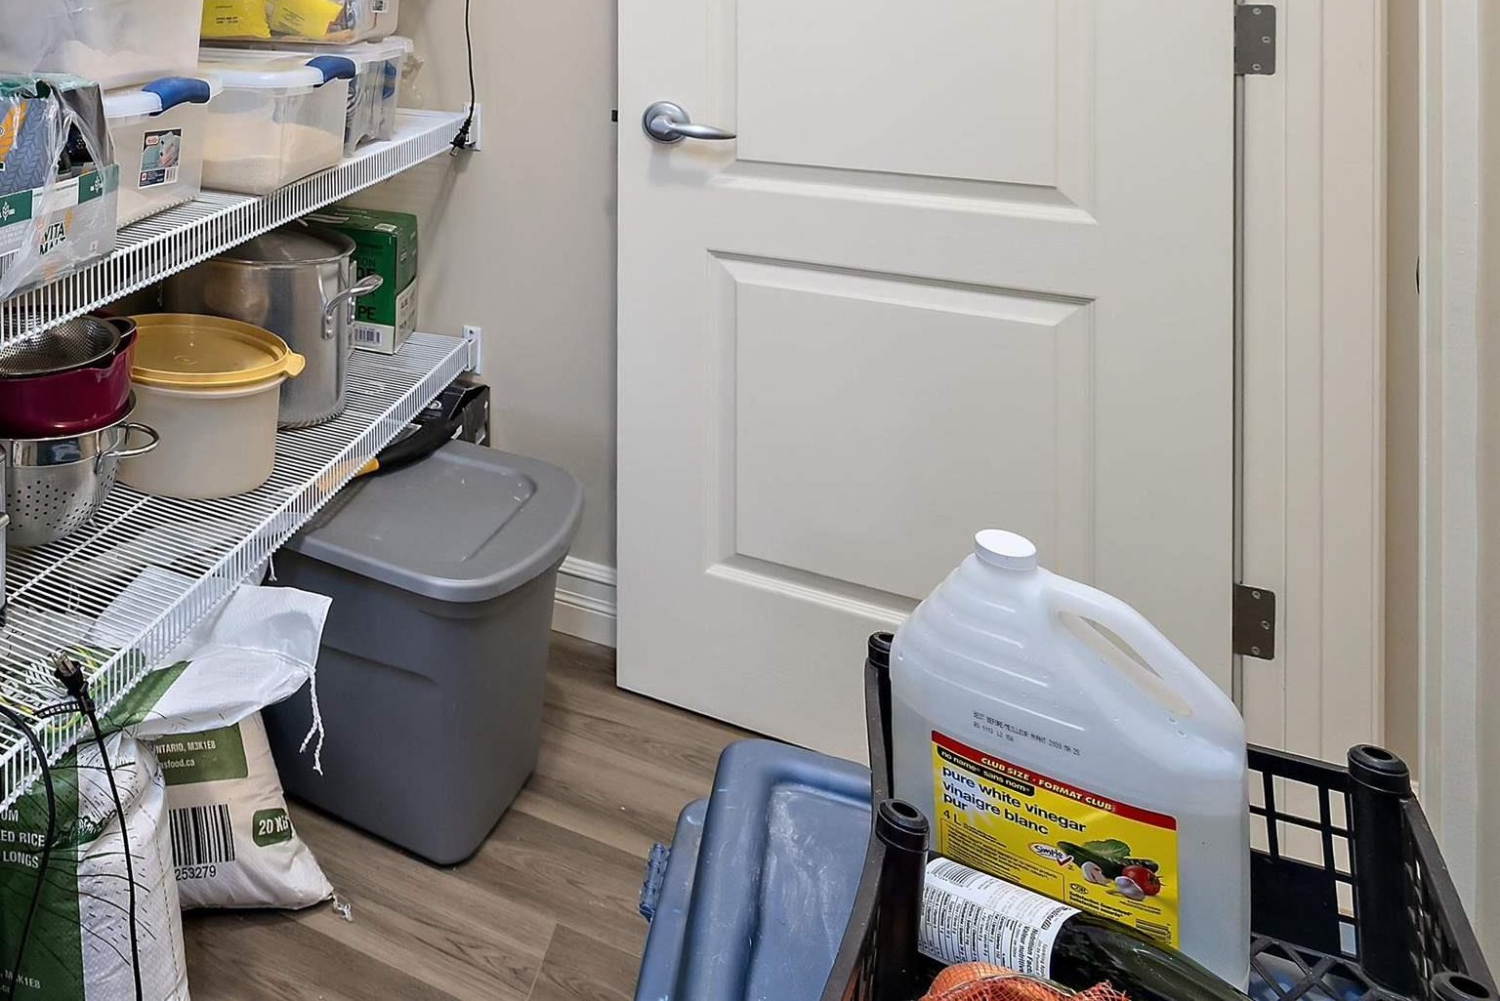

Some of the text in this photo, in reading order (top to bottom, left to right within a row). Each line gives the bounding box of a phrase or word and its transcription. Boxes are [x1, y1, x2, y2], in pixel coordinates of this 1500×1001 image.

[44, 222, 66, 242] VITA
[156, 740, 216, 754] NTARIO, M3K1E8
[941, 750, 953, 762] no
[983, 769, 1004, 785] sans
[981, 756, 1113, 813] CLUB SIZE FORMAT CLUB
[942, 765, 1087, 833] pure white vinegar
[943, 793, 968, 814] pur
[943, 780, 1049, 836] vinaigre blanc
[943, 809, 962, 826] 4 L
[258, 819, 274, 837] 20
[19, 832, 46, 848] RICE
[2, 850, 40, 869] LONGS
[174, 866, 217, 882] 253279
[1018, 925, 1030, 973] Valeur nutritive
[1027, 927, 1039, 956] Nutrition
